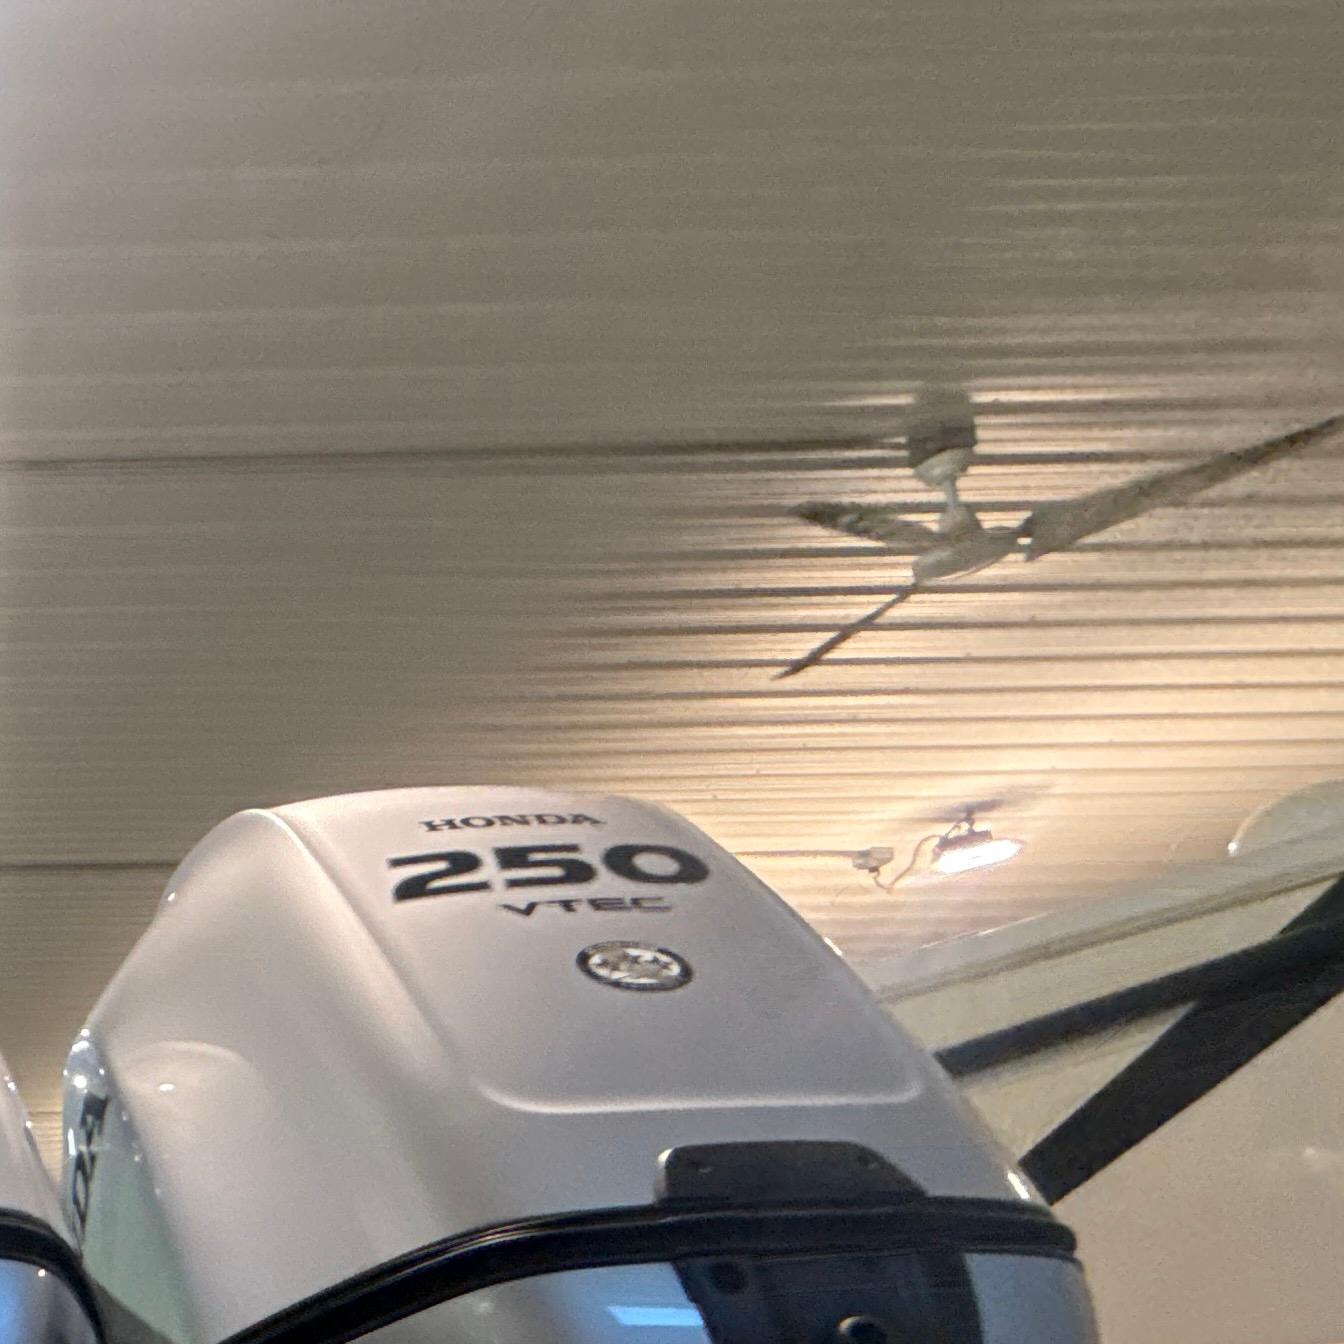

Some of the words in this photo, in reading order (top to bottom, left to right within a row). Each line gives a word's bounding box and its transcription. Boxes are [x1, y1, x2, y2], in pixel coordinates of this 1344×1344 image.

[419, 813, 610, 832] HONDA
[387, 843, 710, 902] 250
[499, 896, 673, 917] VTEC
